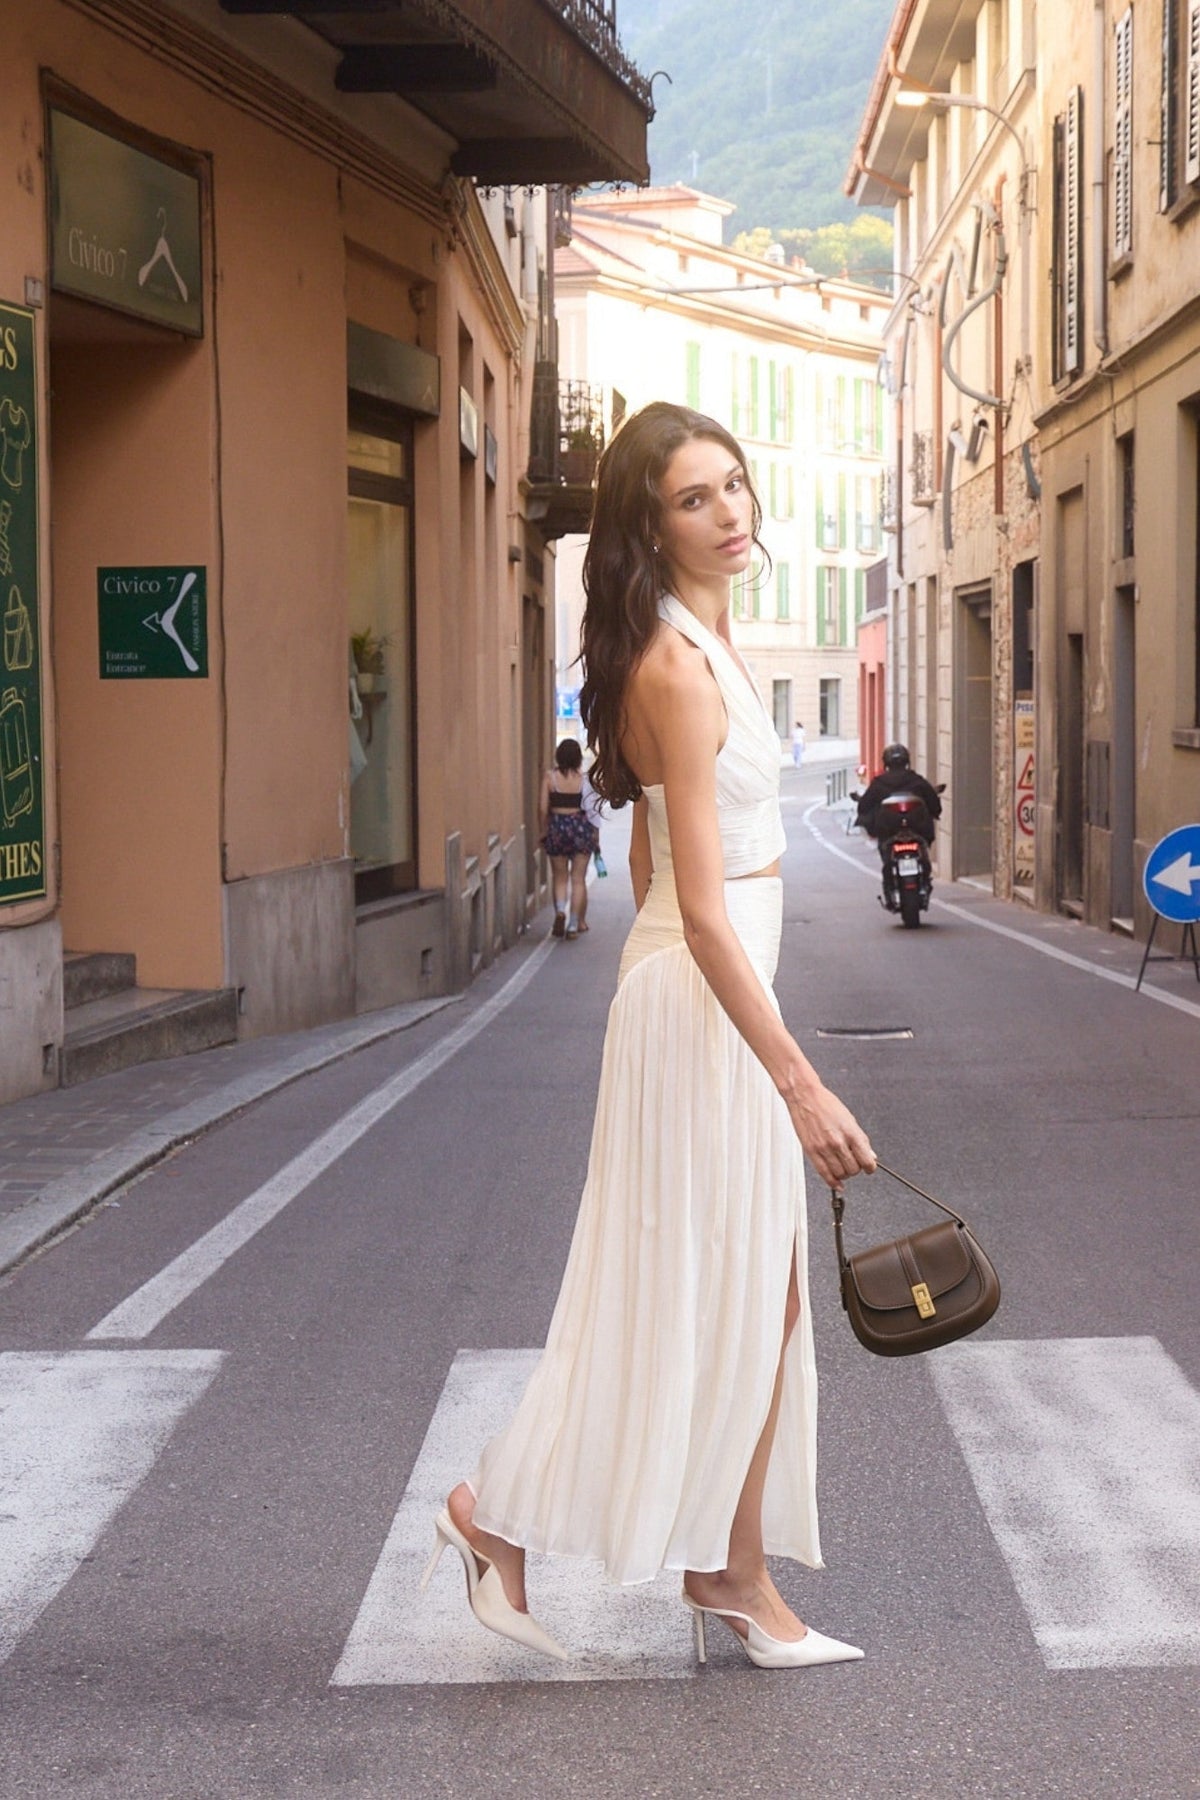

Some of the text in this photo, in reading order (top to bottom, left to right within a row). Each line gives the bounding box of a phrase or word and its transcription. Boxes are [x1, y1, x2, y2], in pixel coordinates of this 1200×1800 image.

[68, 227, 127, 280] Civico 7
[103, 576, 177, 594] Civico 7
